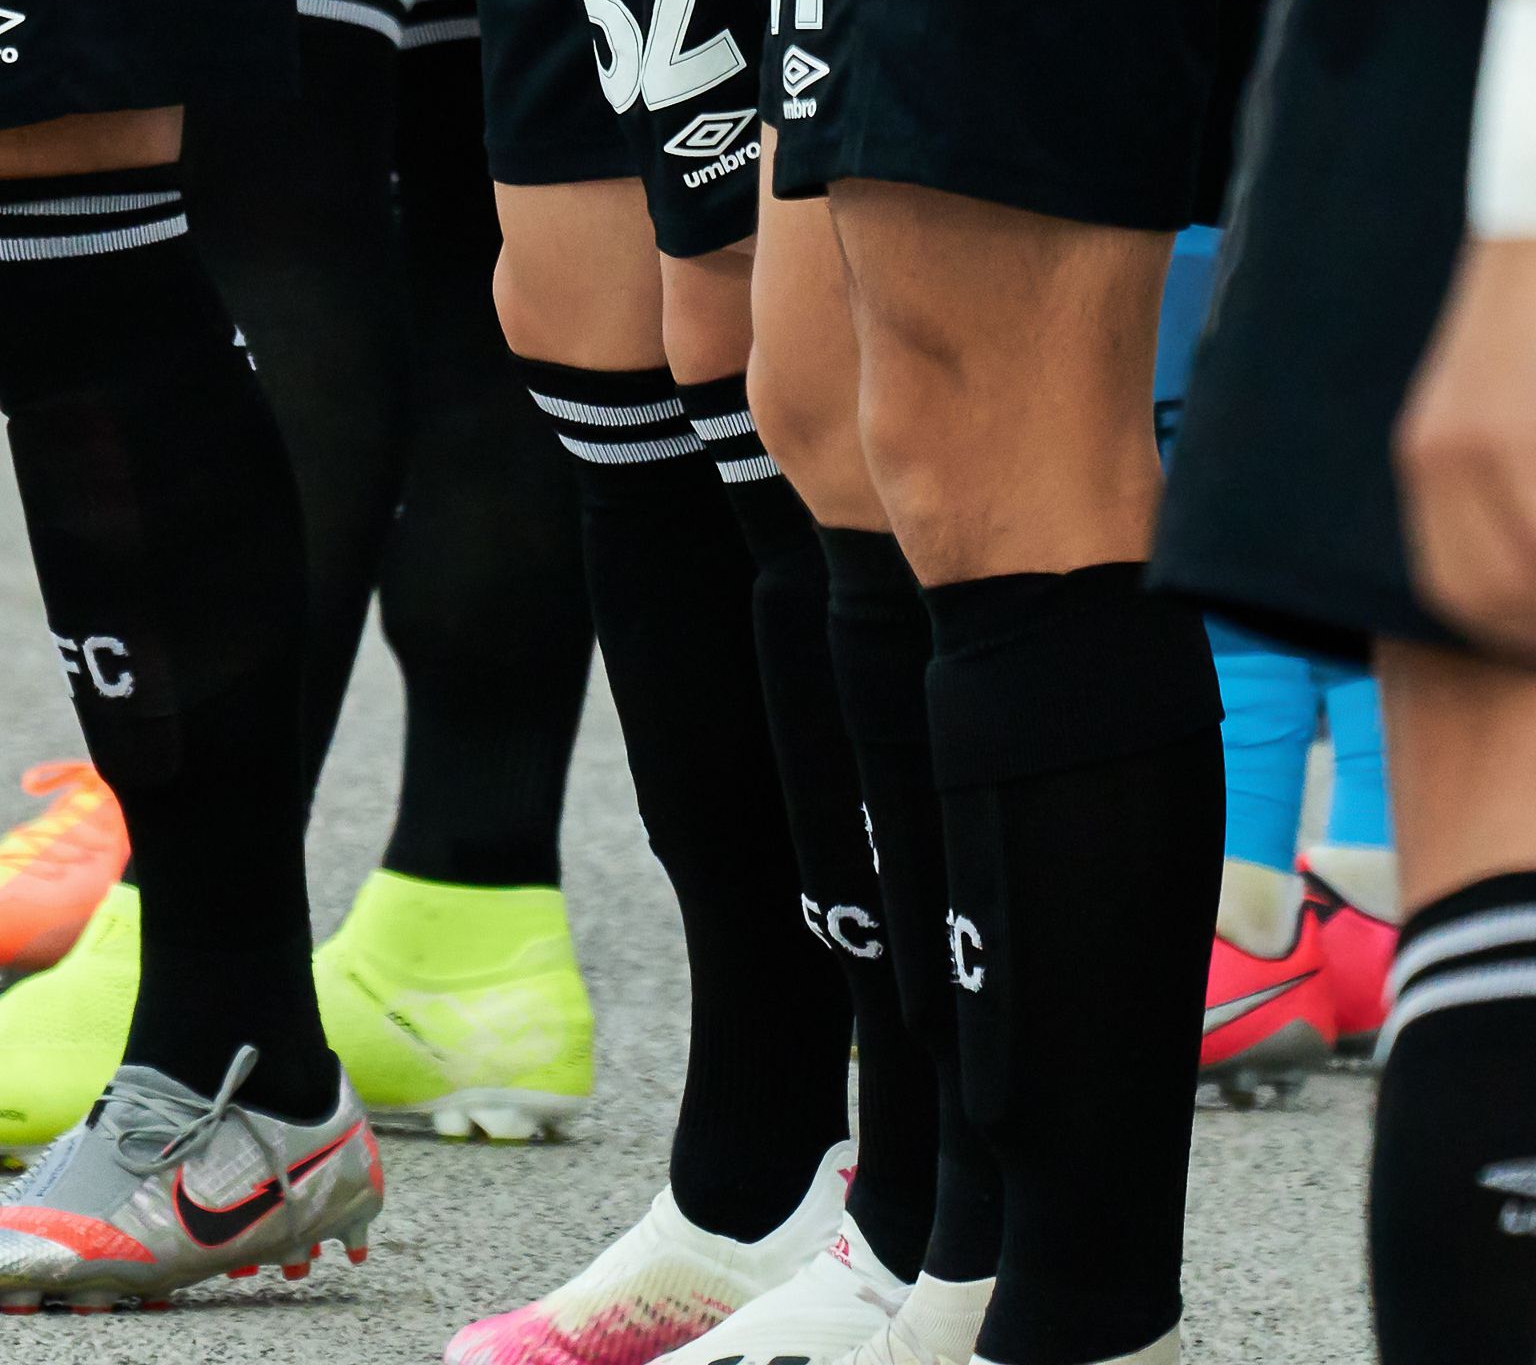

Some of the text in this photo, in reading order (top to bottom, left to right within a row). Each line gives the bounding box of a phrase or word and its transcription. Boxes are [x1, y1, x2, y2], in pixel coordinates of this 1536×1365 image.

[783, 98, 817, 120] mbro
[683, 141, 761, 189] umbro
[48, 629, 134, 698] FC
